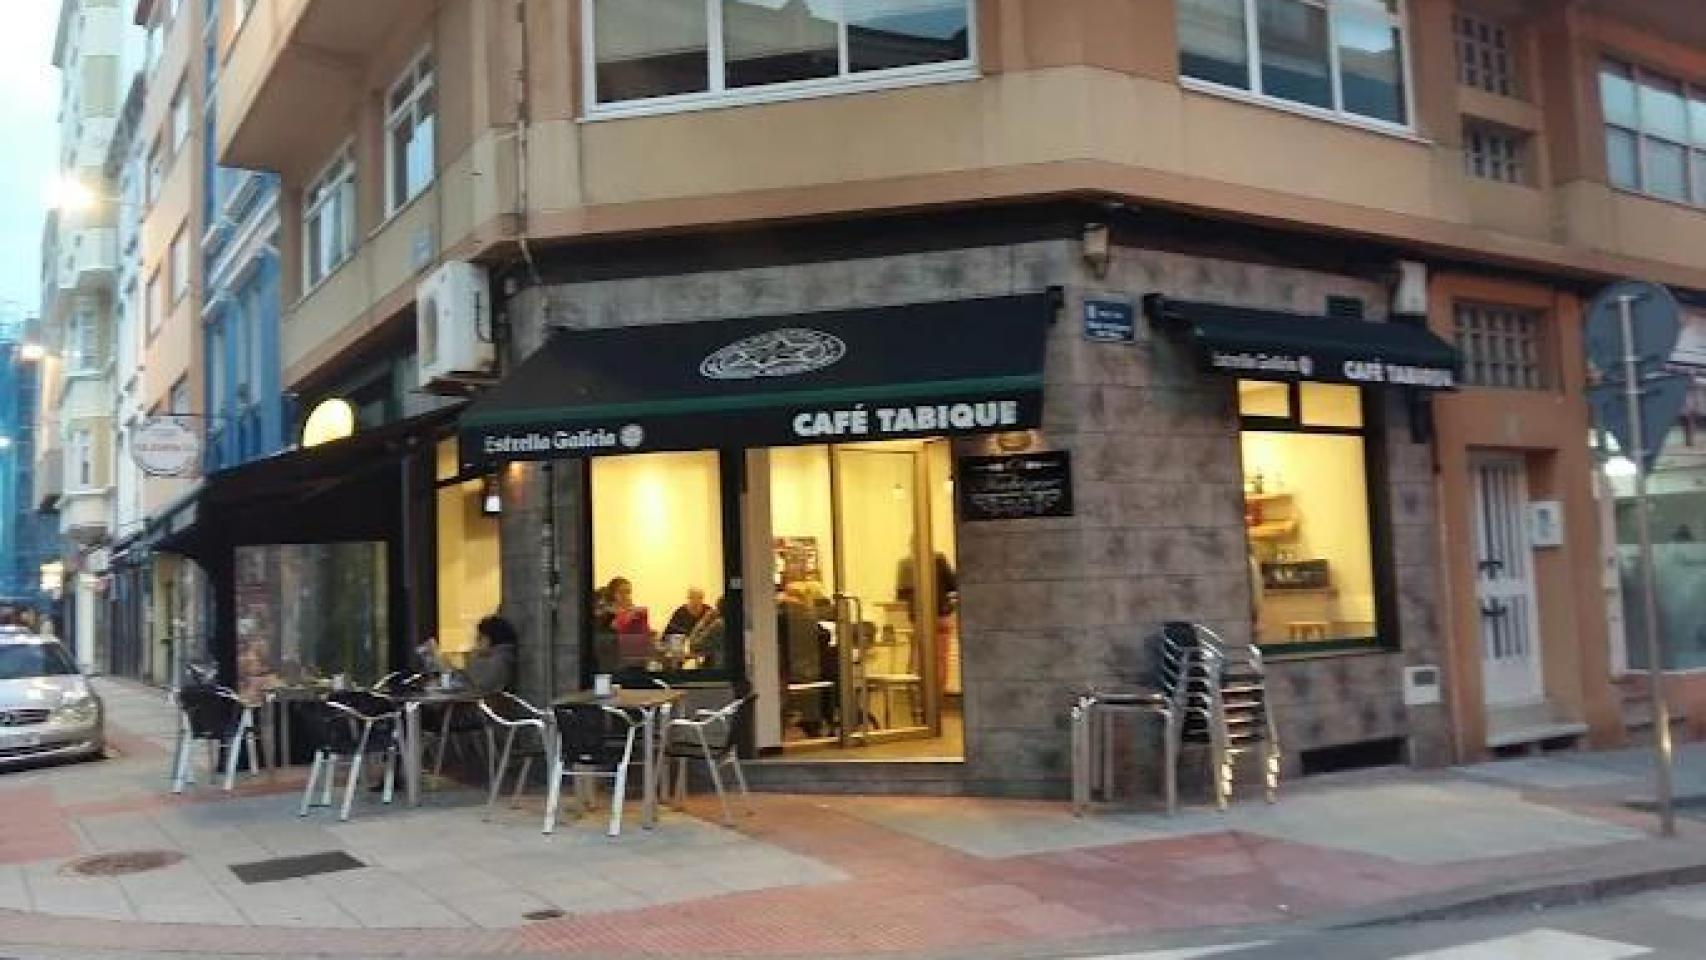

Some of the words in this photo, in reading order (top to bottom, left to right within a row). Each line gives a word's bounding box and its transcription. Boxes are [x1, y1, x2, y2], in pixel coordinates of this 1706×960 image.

[793, 404, 868, 436] CAFÉ
[876, 400, 1017, 432] TABIQUE
[483, 433, 550, 453] Estrella
[554, 429, 616, 449] Galicia
